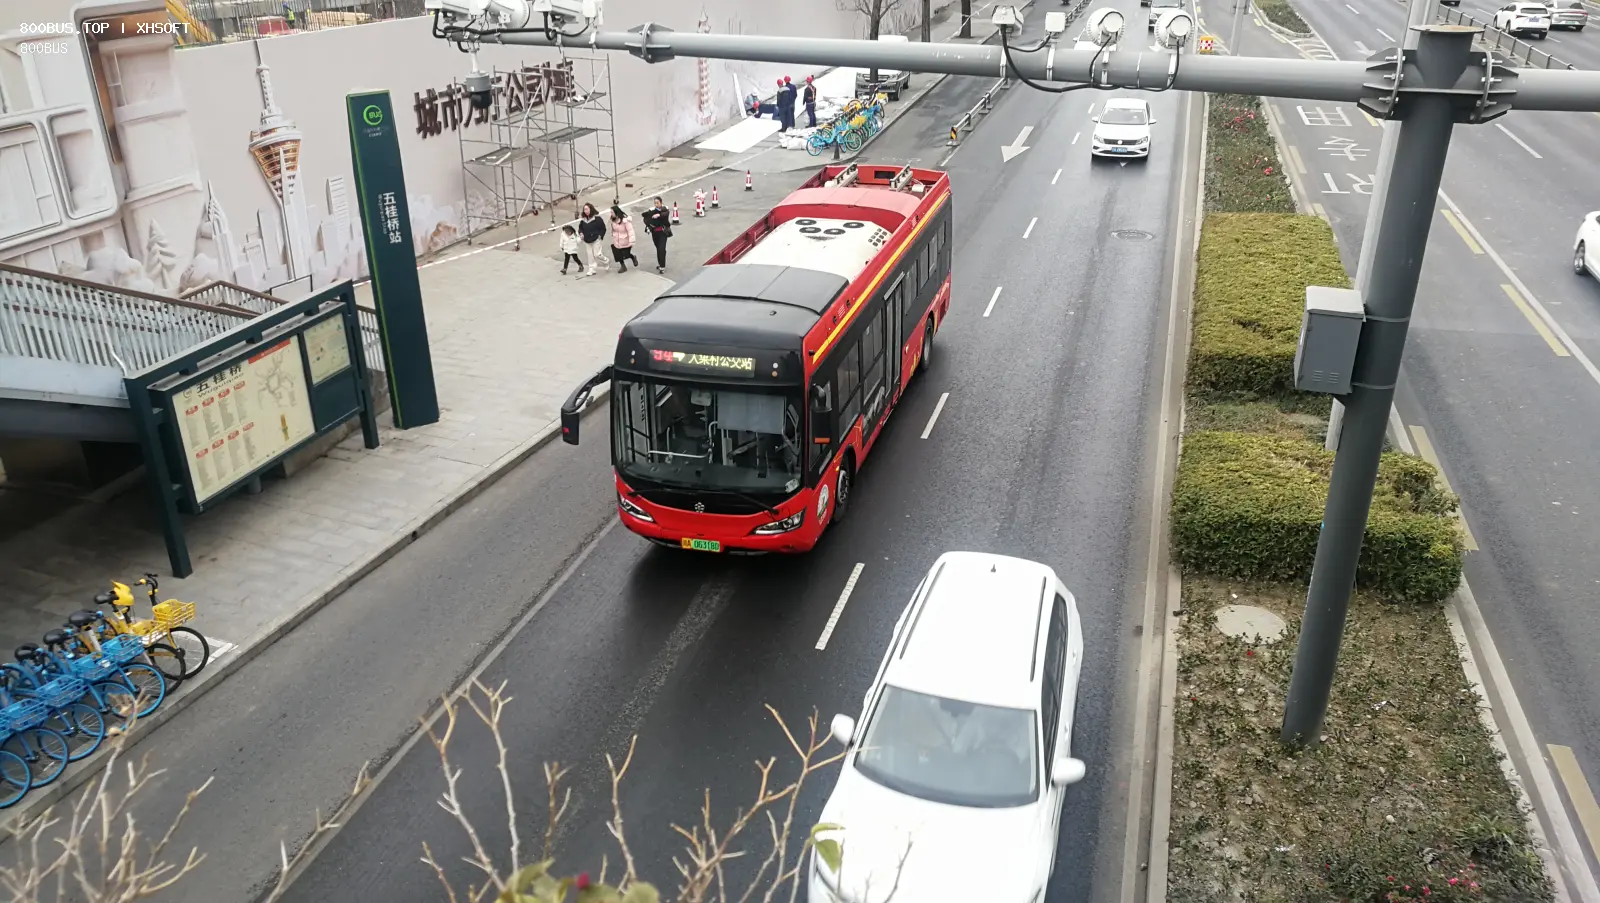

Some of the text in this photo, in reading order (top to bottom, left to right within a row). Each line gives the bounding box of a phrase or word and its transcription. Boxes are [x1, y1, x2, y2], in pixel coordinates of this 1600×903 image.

[1320, 172, 1376, 195] RT
[382, 191, 402, 243] 五桂桥站
[196, 364, 242, 394] 五桂桥
